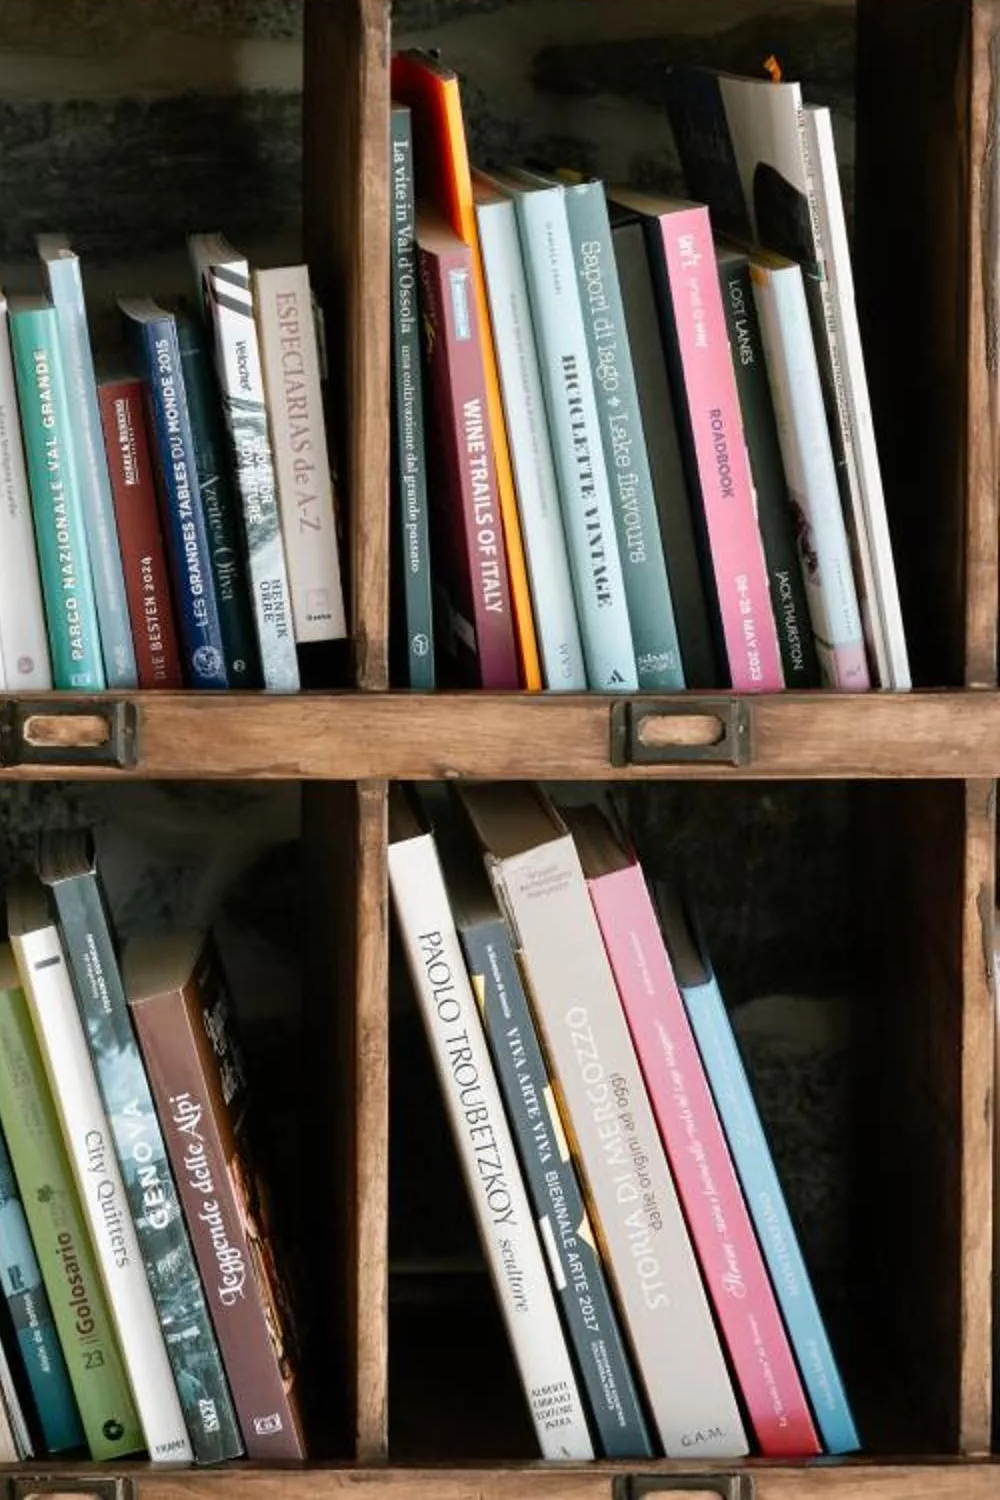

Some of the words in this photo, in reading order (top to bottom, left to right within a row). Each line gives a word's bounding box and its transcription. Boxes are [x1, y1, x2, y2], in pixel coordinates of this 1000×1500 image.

[392, 139, 409, 163] La
[394, 165, 410, 200] vite
[395, 203, 411, 221] in
[396, 223, 413, 253] Val
[397, 256, 414, 333] d'Ossola
[580, 240, 610, 314] Sapori
[728, 279, 745, 315] LOST
[592, 317, 616, 340] di
[734, 318, 753, 364] LANES
[155, 338, 172, 372] 2015
[275, 292, 312, 452] ESPECIARIAS
[595, 341, 619, 391] lago
[33, 349, 55, 428] GRANDE
[161, 375, 180, 432] MONDE
[402, 371, 414, 450] coltivazione
[169, 435, 185, 459] DU
[463, 398, 485, 452] WINE
[608, 411, 632, 467] Lake
[45, 434, 60, 471] VAL
[293, 457, 316, 484] de
[709, 408, 734, 498] ROADBOOK
[173, 461, 192, 518] TABLES
[402, 474, 420, 520] grande
[469, 454, 493, 524] TRAILS
[562, 355, 594, 498] BICICLETTE
[584, 507, 610, 606] VINTAGE
[50, 479, 75, 588] NAZIONALE
[296, 491, 321, 532] A-Z
[617, 472, 646, 563] flavours
[181, 521, 203, 595] GRANDES
[405, 522, 419, 572] passato
[476, 528, 496, 555] OF
[140, 555, 154, 591] 2024
[480, 560, 502, 612] ITALY
[65, 594, 86, 660] PARCO
[144, 595, 162, 650] BESTEN
[192, 598, 209, 627] LES
[259, 580, 274, 622] ORRE
[266, 579, 288, 638] HENRIK
[774, 571, 792, 601] JACK
[783, 601, 803, 670] THURSTON
[743, 618, 757, 647] MAY
[151, 655, 166, 679] DIE
[418, 931, 460, 1022] PAOLO
[446, 1030, 515, 1224] TROUBETZKOY
[564, 1007, 633, 1164] MERGOZZO
[609, 1072, 629, 1108] oggi
[168, 1092, 204, 1141] Alpi
[617, 1111, 635, 1131] ad
[119, 1095, 171, 1228] GENOVA
[183, 1143, 213, 1192] delle
[506, 1026, 526, 1068] VIVA
[517, 1073, 540, 1119] ARTE
[532, 1121, 551, 1163] VIVA
[544, 1170, 576, 1248] BIENNALE
[567, 1252, 589, 1292] ARTE
[578, 1295, 599, 1331] 2017
[627, 1136, 651, 1188] origini
[84, 1129, 106, 1172] City
[96, 1179, 129, 1268] Quitters
[612, 1173, 638, 1204] DI
[642, 1192, 663, 1231] dalle
[198, 1200, 245, 1305] Leggende
[498, 1238, 528, 1311] scultore
[623, 1208, 669, 1309] STORIA
